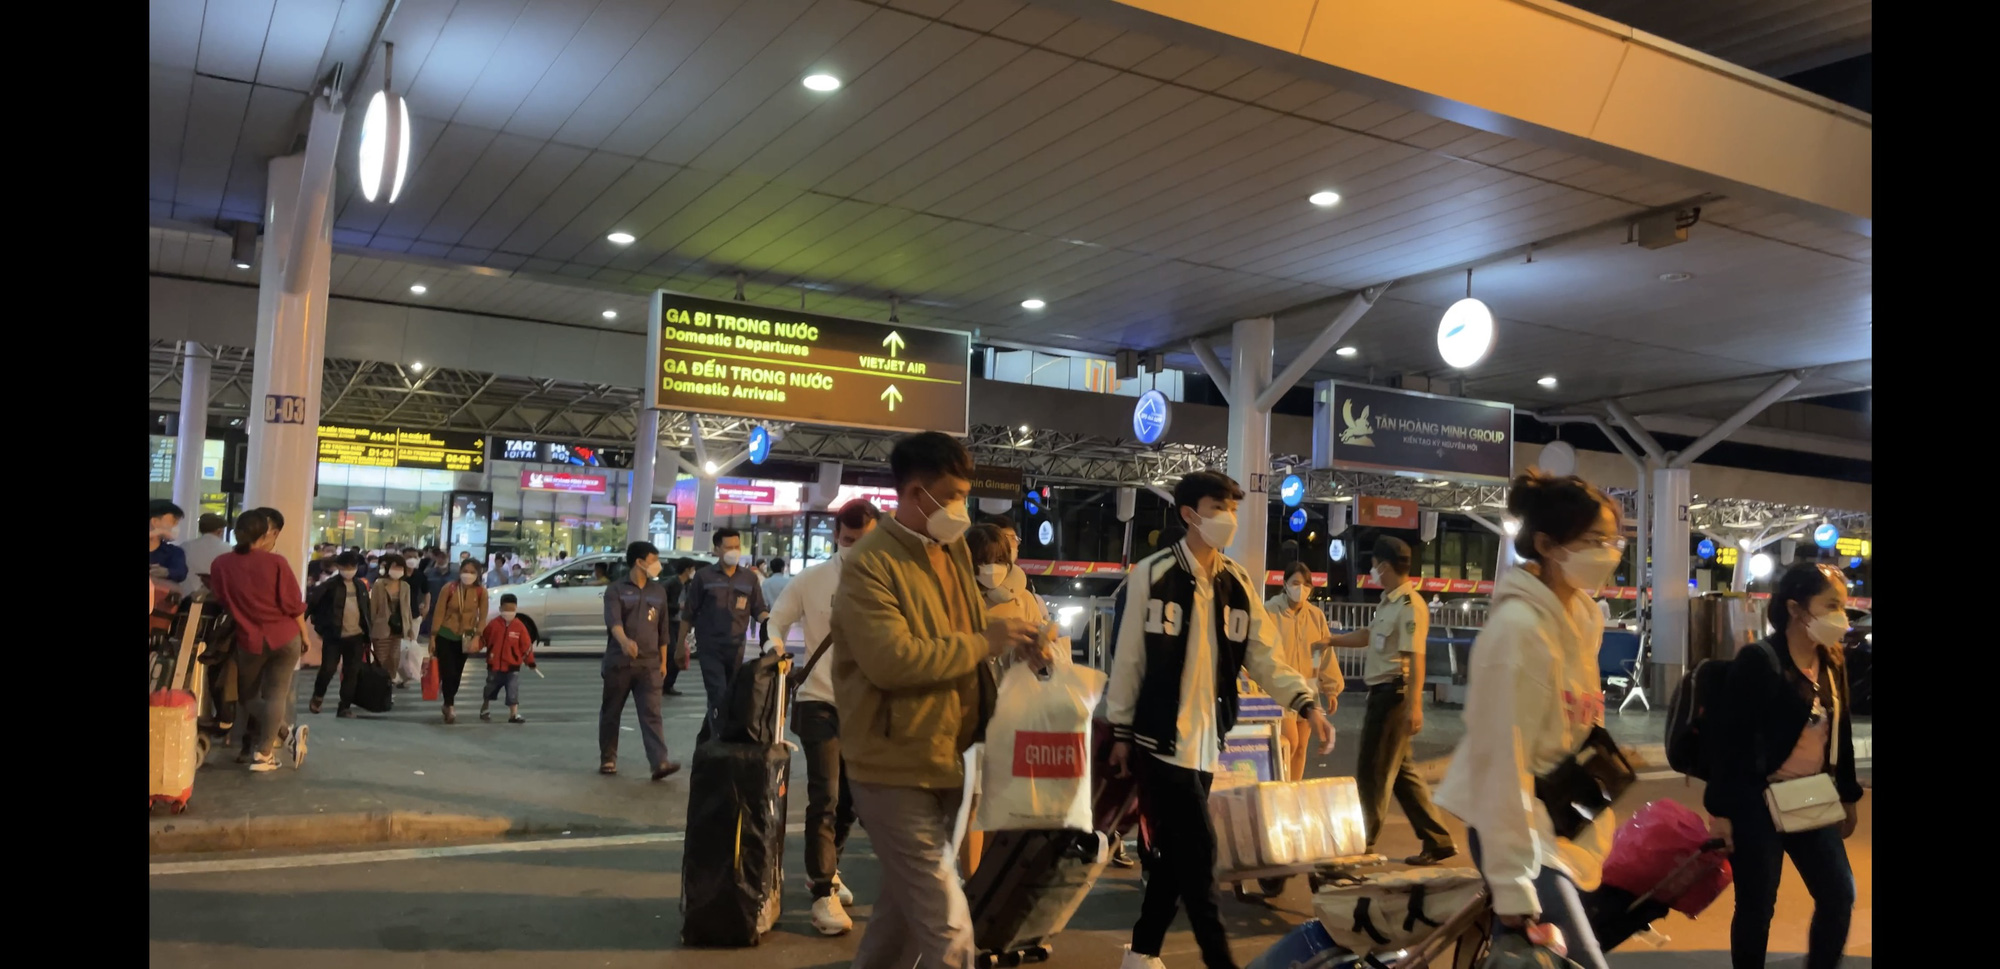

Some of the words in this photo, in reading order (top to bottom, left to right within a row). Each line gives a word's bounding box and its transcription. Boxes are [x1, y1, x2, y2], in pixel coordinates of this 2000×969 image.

[666, 308, 690, 325] GA
[694, 311, 712, 328] ĐI
[714, 314, 771, 335] TRONG
[774, 322, 818, 341] NƯỚC
[665, 326, 732, 347] Domestic
[735, 335, 809, 357] Departures
[663, 358, 688, 375] GA
[691, 358, 727, 379] ĐẾN
[730, 365, 786, 386] TRONG
[789, 371, 834, 390] NƯỚC
[859, 355, 905, 372] VIETJET
[907, 361, 926, 375] AIR
[662, 376, 730, 397] Domestic
[732, 384, 786, 402] Arrivals
[264, 396, 305, 424] B-03
[1398, 417, 1440, 436] HOÀNG
[1440, 424, 1467, 439] MINH
[1469, 427, 1505, 444] GROUP
[985, 480, 1020, 493] Ginseng
[1144, 598, 1183, 636] 19
[1025, 744, 1075, 767] CANIFA
